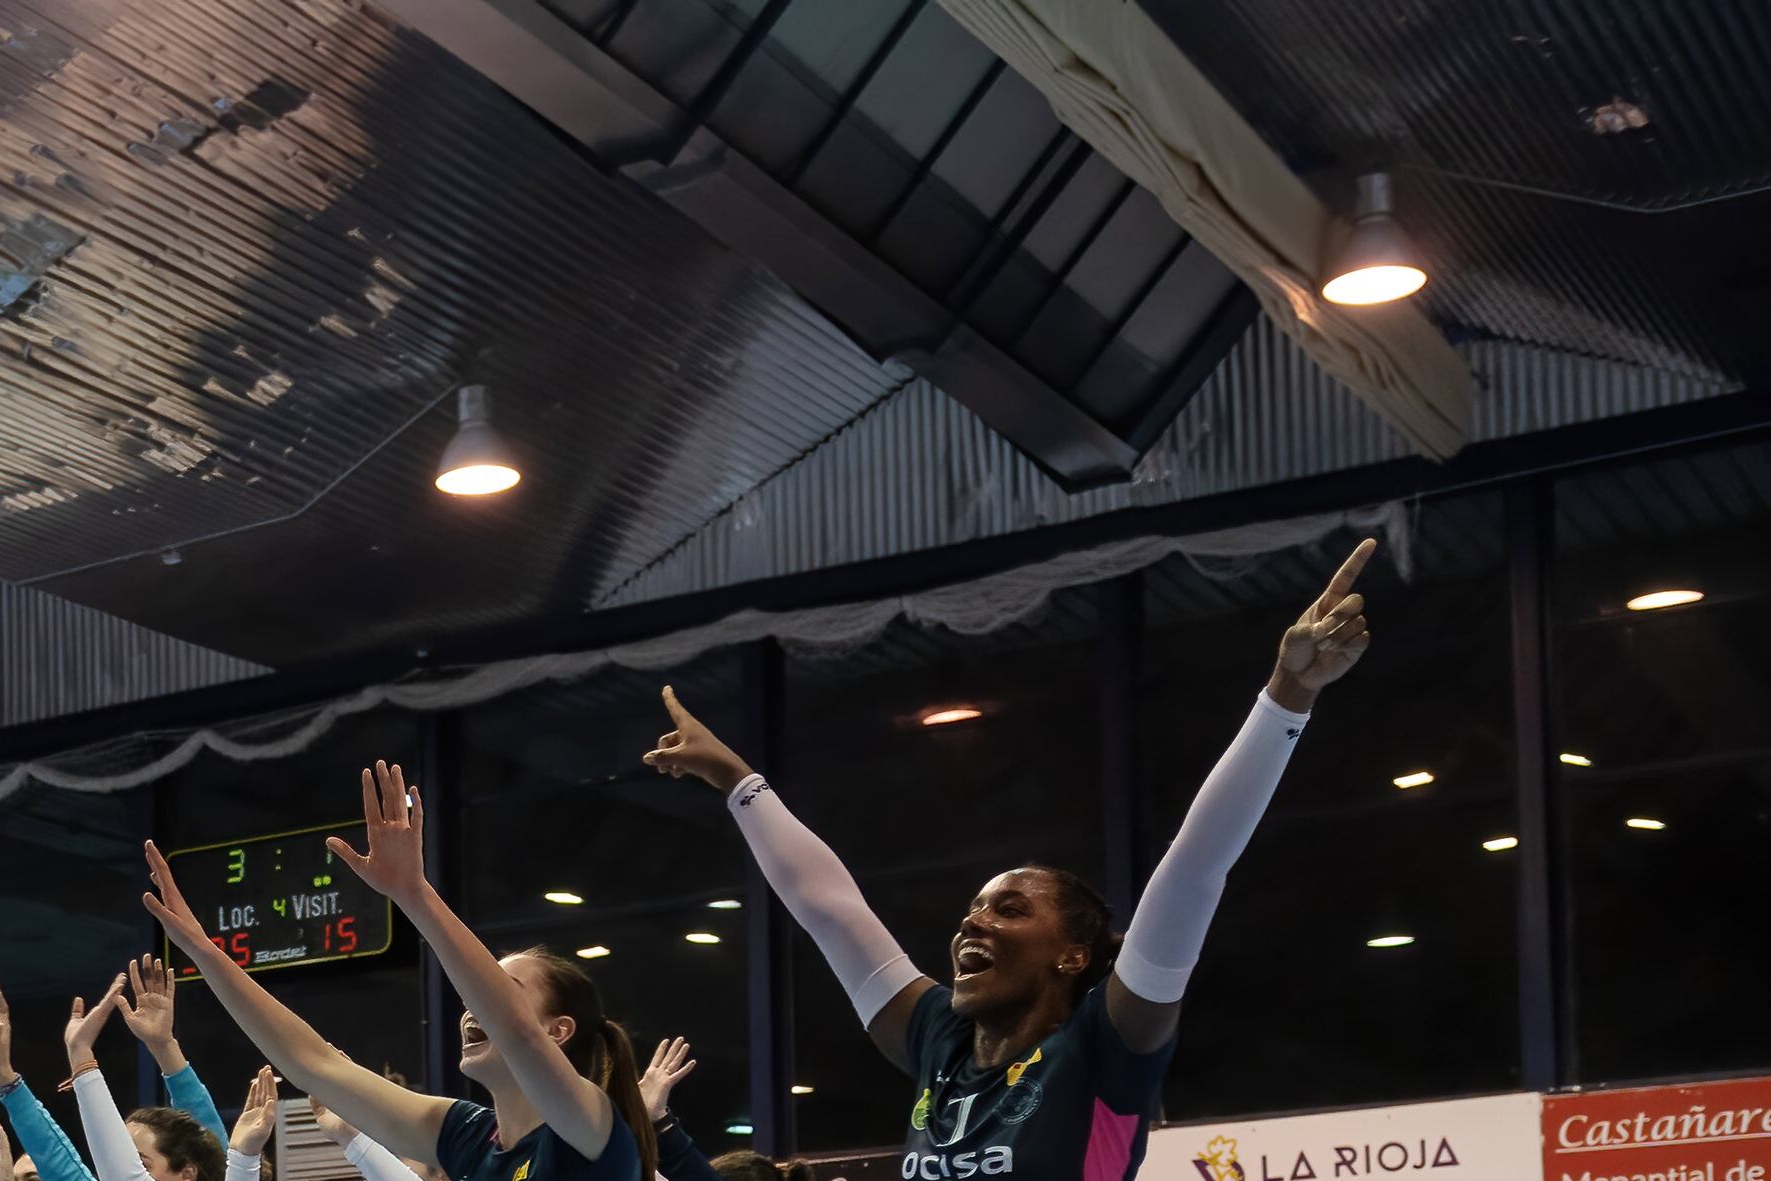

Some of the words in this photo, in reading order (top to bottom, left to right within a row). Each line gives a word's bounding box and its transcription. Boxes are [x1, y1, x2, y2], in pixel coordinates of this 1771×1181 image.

[218, 905, 260, 932] LOC.
[292, 891, 343, 920] VISIT.
[324, 916, 357, 953] 15
[1333, 1136, 1460, 1178] RIOJA
